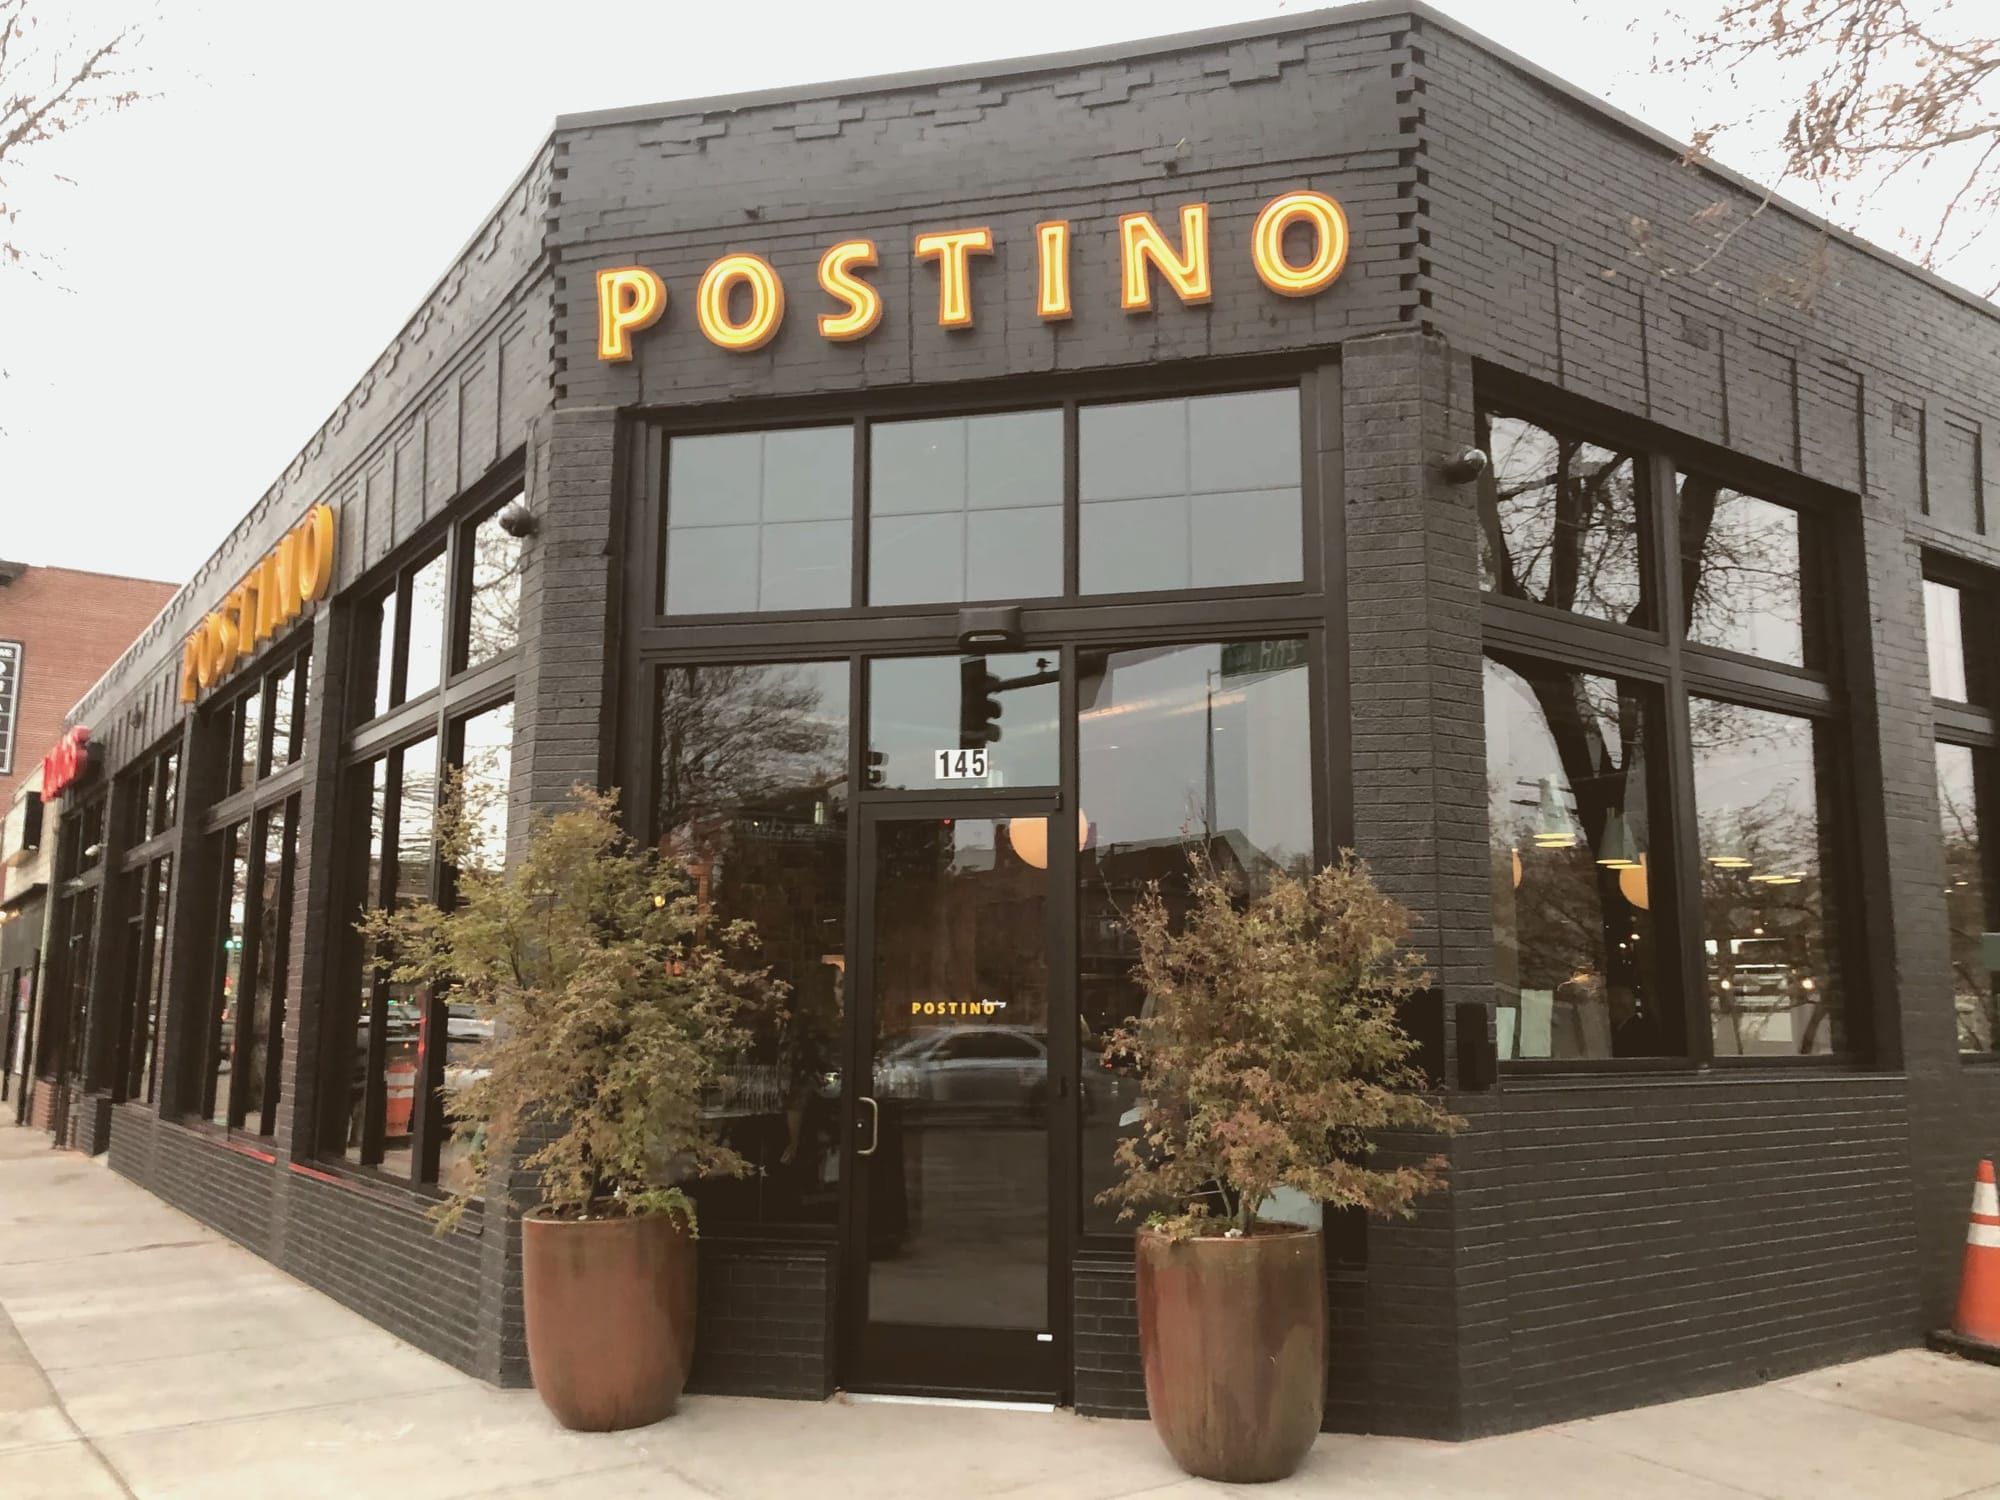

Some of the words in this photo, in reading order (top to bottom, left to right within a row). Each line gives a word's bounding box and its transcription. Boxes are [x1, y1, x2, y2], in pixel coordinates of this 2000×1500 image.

[597, 190, 1349, 362] POSTINO
[180, 503, 334, 703] POSTINO
[939, 750, 985, 778] 145
[911, 1002, 996, 1015] POSTINO
